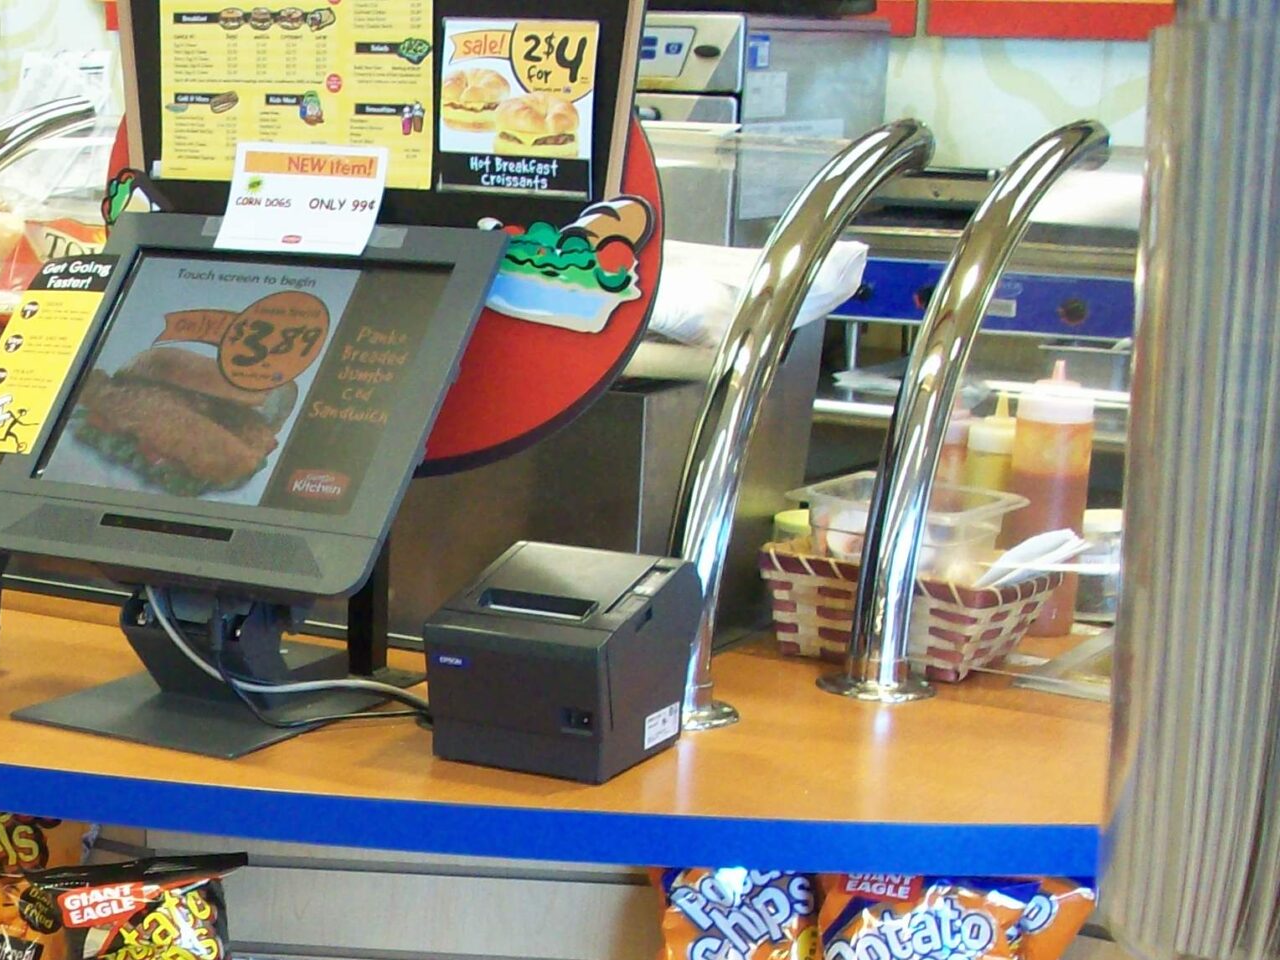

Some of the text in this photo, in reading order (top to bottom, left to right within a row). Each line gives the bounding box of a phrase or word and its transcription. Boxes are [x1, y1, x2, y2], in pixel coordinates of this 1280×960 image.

[463, 33, 506, 55] sale!
[524, 34, 542, 62] 2
[288, 156, 326, 173] NEW
[470, 157, 491, 172] Hot
[481, 172, 548, 190] Croissants
[236, 197, 261, 206] CORN
[265, 198, 292, 208] DOGS
[309, 198, 347, 210] ONLY
[42, 260, 112, 278] Get Going
[47, 276, 92, 289] Faster!
[177, 268, 317, 289] Touch screen to begin
[356, 327, 410, 344] Panko
[341, 345, 409, 364] Breaded
[337, 367, 394, 383] Jumbo
[342, 388, 374, 401] Cod
[308, 402, 389, 424] Sandwich
[292, 480, 342, 495] Kitchen
[439, 655, 462, 666] EPSON
[64, 884, 134, 911] GIANT
[845, 880, 912, 899] EAGLE
[70, 896, 136, 924] EAGLE
